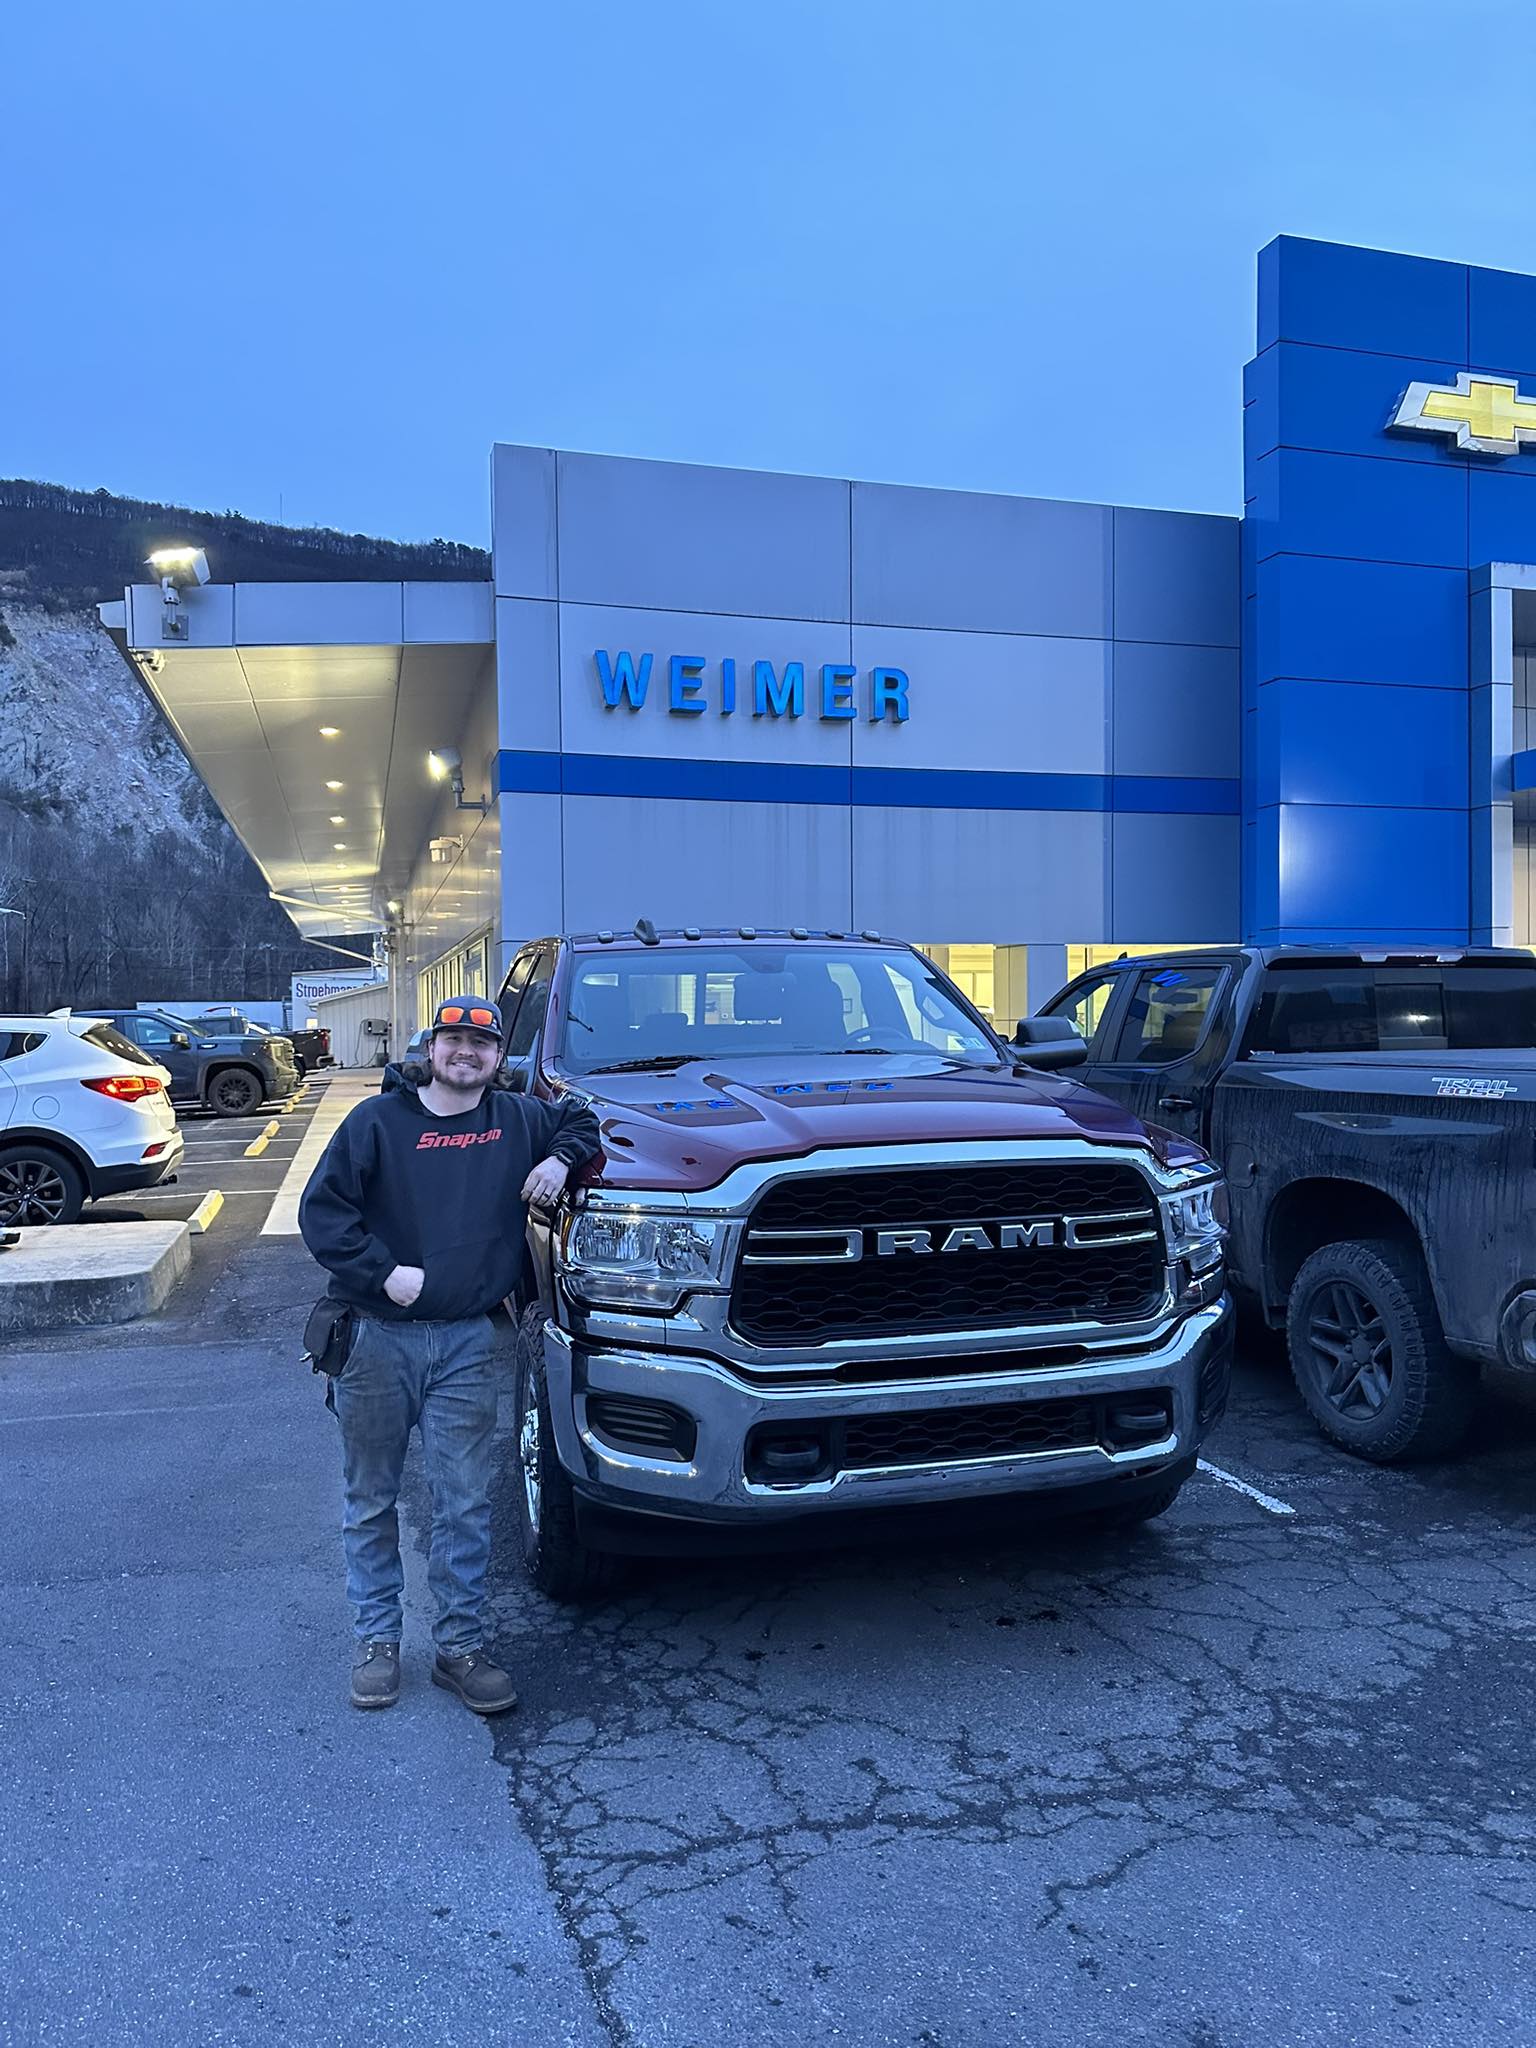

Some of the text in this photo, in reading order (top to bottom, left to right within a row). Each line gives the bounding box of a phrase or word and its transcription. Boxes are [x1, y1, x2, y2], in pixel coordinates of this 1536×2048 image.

[594, 649, 910, 723] WEIMER
[296, 982, 357, 998] Stroehma
[1432, 1077, 1518, 1093] TRAIL
[1437, 1087, 1505, 1099] BOSS
[415, 1128, 503, 1150] Snap-on
[877, 1221, 1055, 1256] RAM
